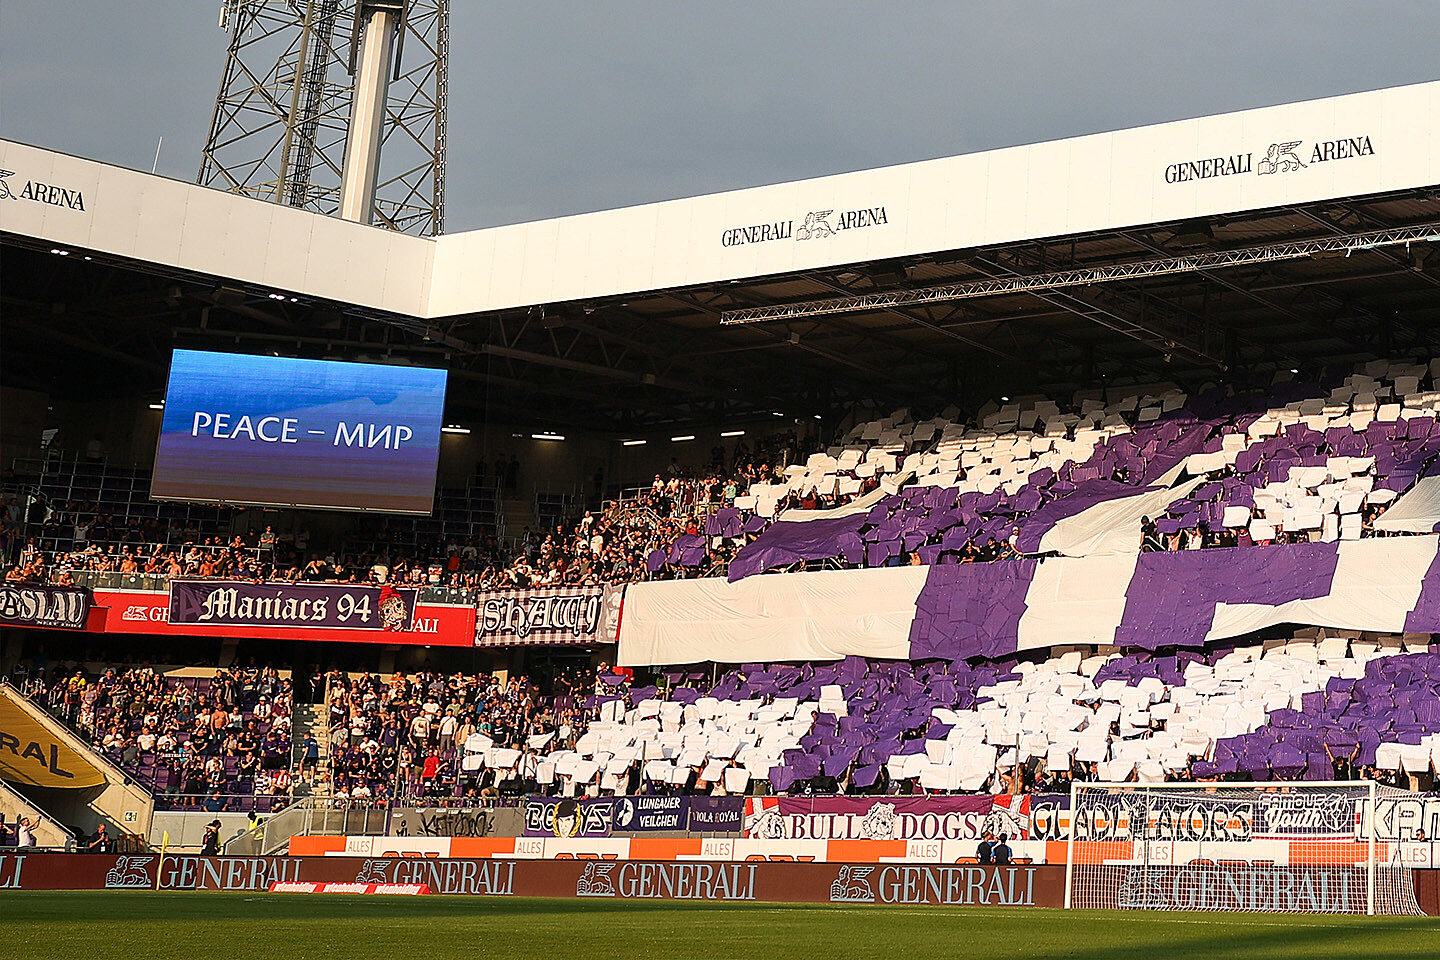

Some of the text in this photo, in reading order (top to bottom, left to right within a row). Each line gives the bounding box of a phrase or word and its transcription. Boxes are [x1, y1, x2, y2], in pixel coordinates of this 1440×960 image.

[1165, 135, 1376, 184] GENERALI ARENA
[19, 181, 86, 212] ARENA
[722, 206, 889, 248] GENERALI ARENA
[191, 410, 299, 443] PEACE
[333, 421, 414, 450] МИР
[198, 587, 372, 623] Maniacs 94
[637, 797, 681, 810] LUNGAUER
[639, 814, 678, 828] VEILCHEN
[791, 813, 980, 840] BULL DOGS
[1263, 808, 1323, 834] Youth
[347, 840, 371, 853] ALLES
[517, 841, 542, 855] ALLES
[704, 842, 730, 855] ALLES
[909, 844, 938, 858] ALLES
[159, 856, 302, 890] GENERALI
[393, 860, 517, 895] GENERALI
[618, 863, 758, 900] GENERALI
[878, 866, 1037, 905] GENERALI
[1172, 869, 1350, 911] GENERALI
